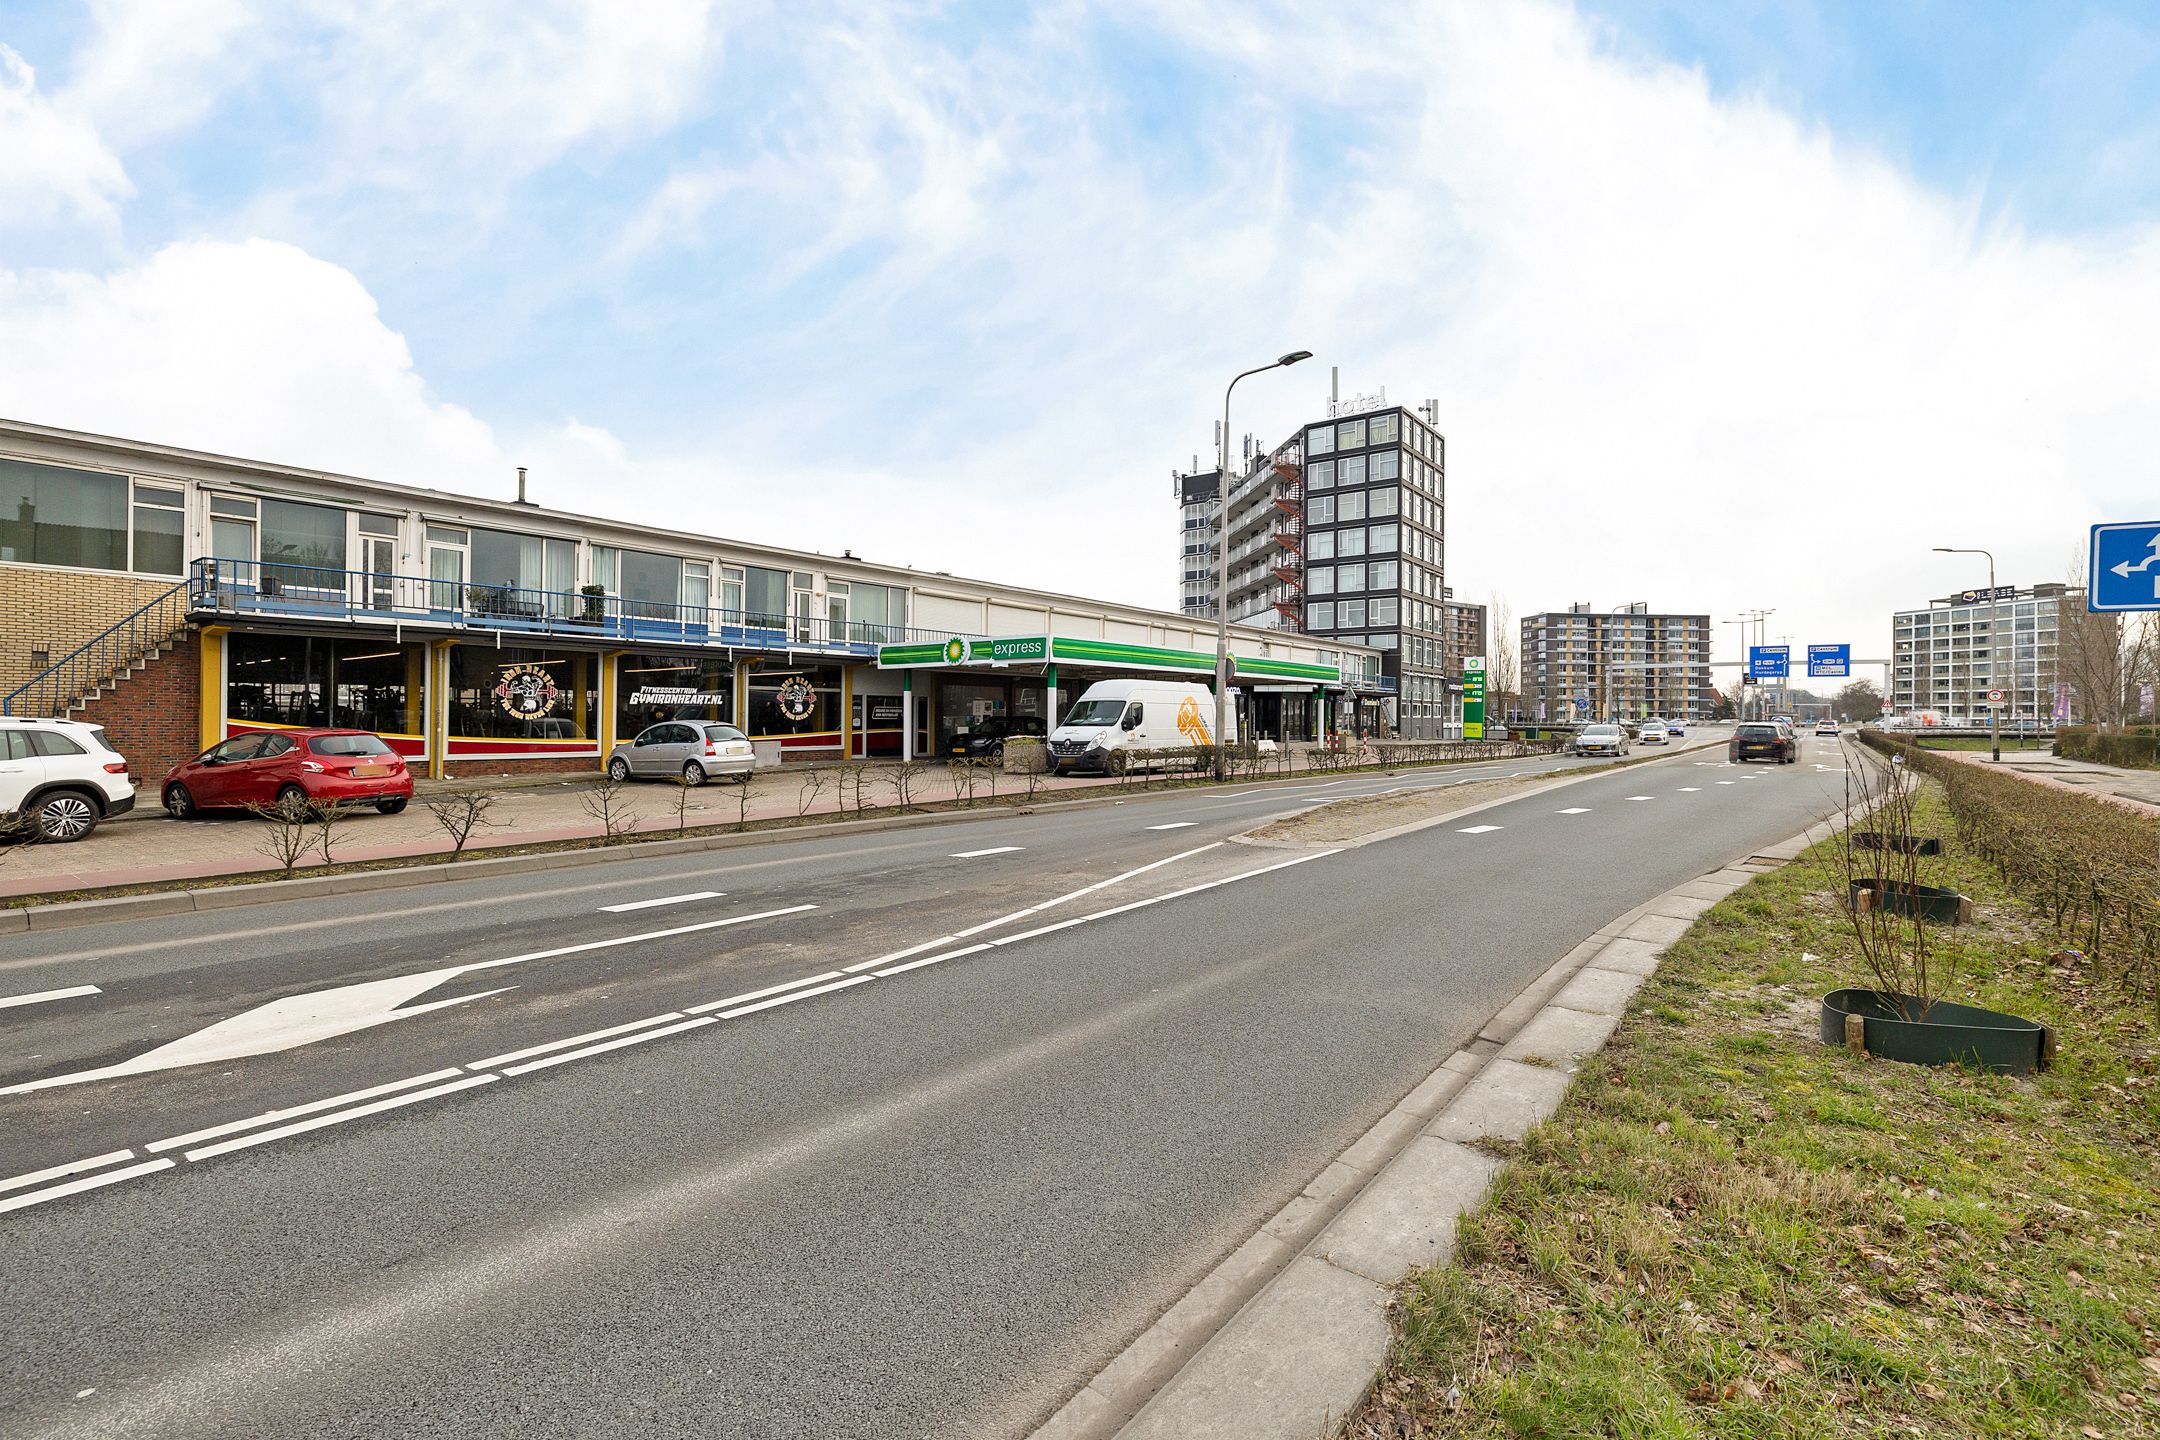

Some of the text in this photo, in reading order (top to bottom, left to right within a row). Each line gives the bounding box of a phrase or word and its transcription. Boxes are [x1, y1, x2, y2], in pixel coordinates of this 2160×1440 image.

[1326, 385, 1387, 418] hotel
[994, 642, 1042, 657] express
[629, 692, 723, 704] GYMIRONHEART.NL
